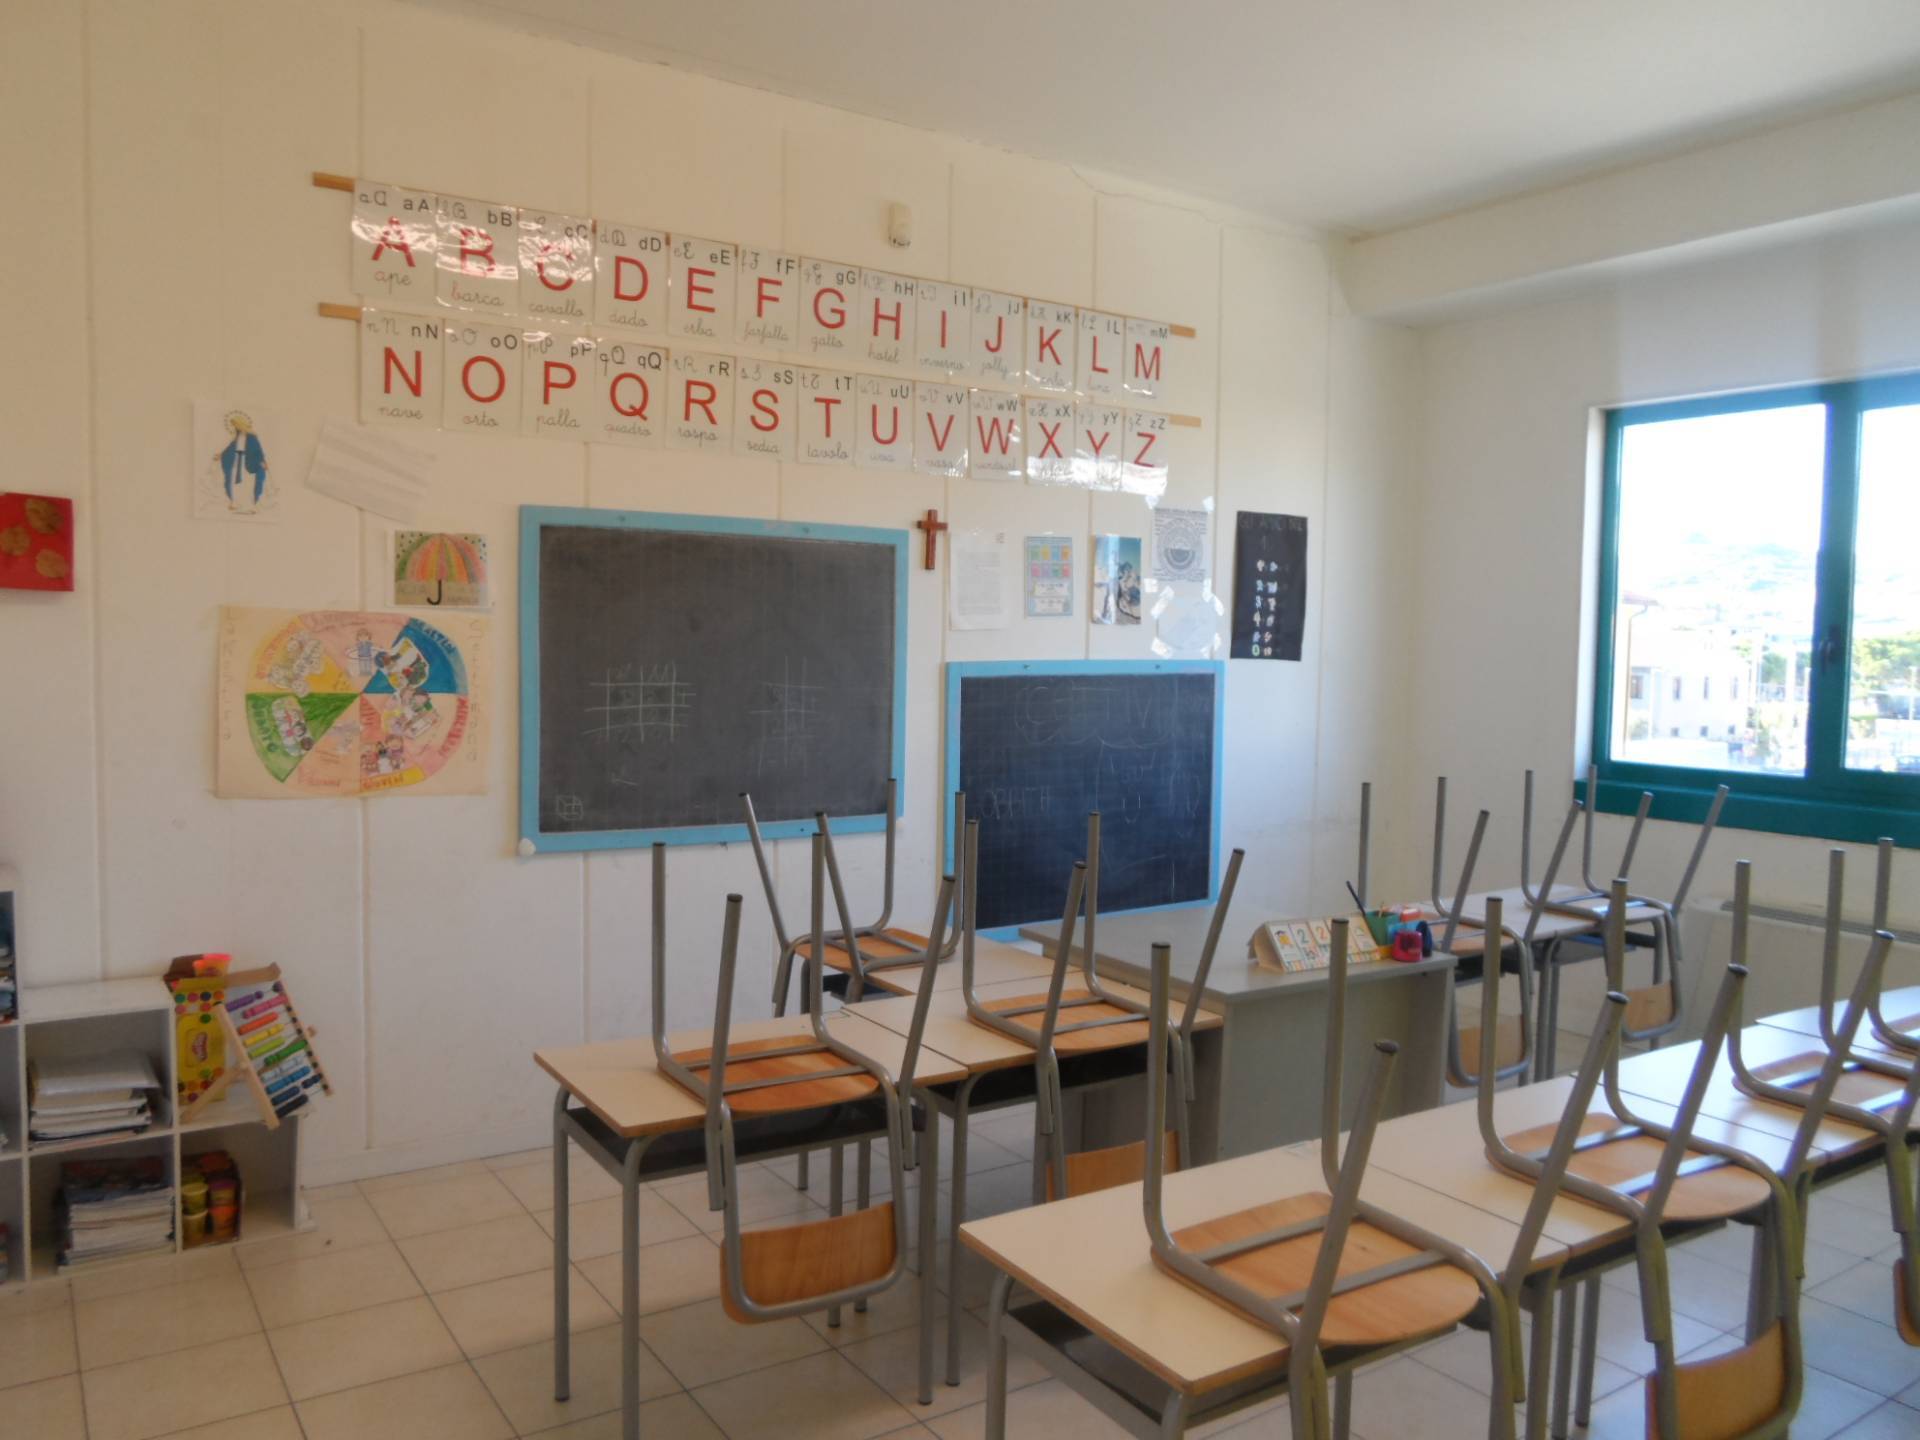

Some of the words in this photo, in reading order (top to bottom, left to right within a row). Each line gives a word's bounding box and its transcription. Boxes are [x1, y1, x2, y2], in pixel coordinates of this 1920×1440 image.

[371, 216, 416, 268] A
[460, 227, 497, 277] B
[375, 268, 412, 294] ape
[451, 282, 504, 306] barca
[614, 255, 649, 302] D
[686, 266, 716, 314] E
[757, 276, 783, 318] F
[528, 300, 584, 318] cavallo
[609, 307, 649, 326] dado
[683, 317, 715, 337] erba
[813, 287, 847, 329] G
[873, 297, 902, 341] H
[867, 343, 900, 364] hotel
[985, 315, 1004, 353] J
[1039, 325, 1063, 366] K
[384, 346, 422, 397] N
[1091, 335, 1109, 374] L
[1134, 342, 1161, 381] M
[461, 355, 506, 403] O
[543, 360, 577, 405] P
[609, 372, 649, 421] Q
[377, 405, 424, 420] nave
[462, 411, 499, 428] orto
[535, 408, 581, 433] palla
[684, 379, 718, 426] R
[750, 388, 780, 432] S
[814, 396, 842, 438] T
[871, 403, 898, 445] U
[926, 411, 955, 452] V
[976, 415, 1015, 455] W
[1038, 421, 1063, 458] X
[1085, 428, 1110, 460] Y
[746, 438, 779, 454] sedia
[1133, 431, 1156, 468] Z
[1297, 927, 1309, 945] 2
